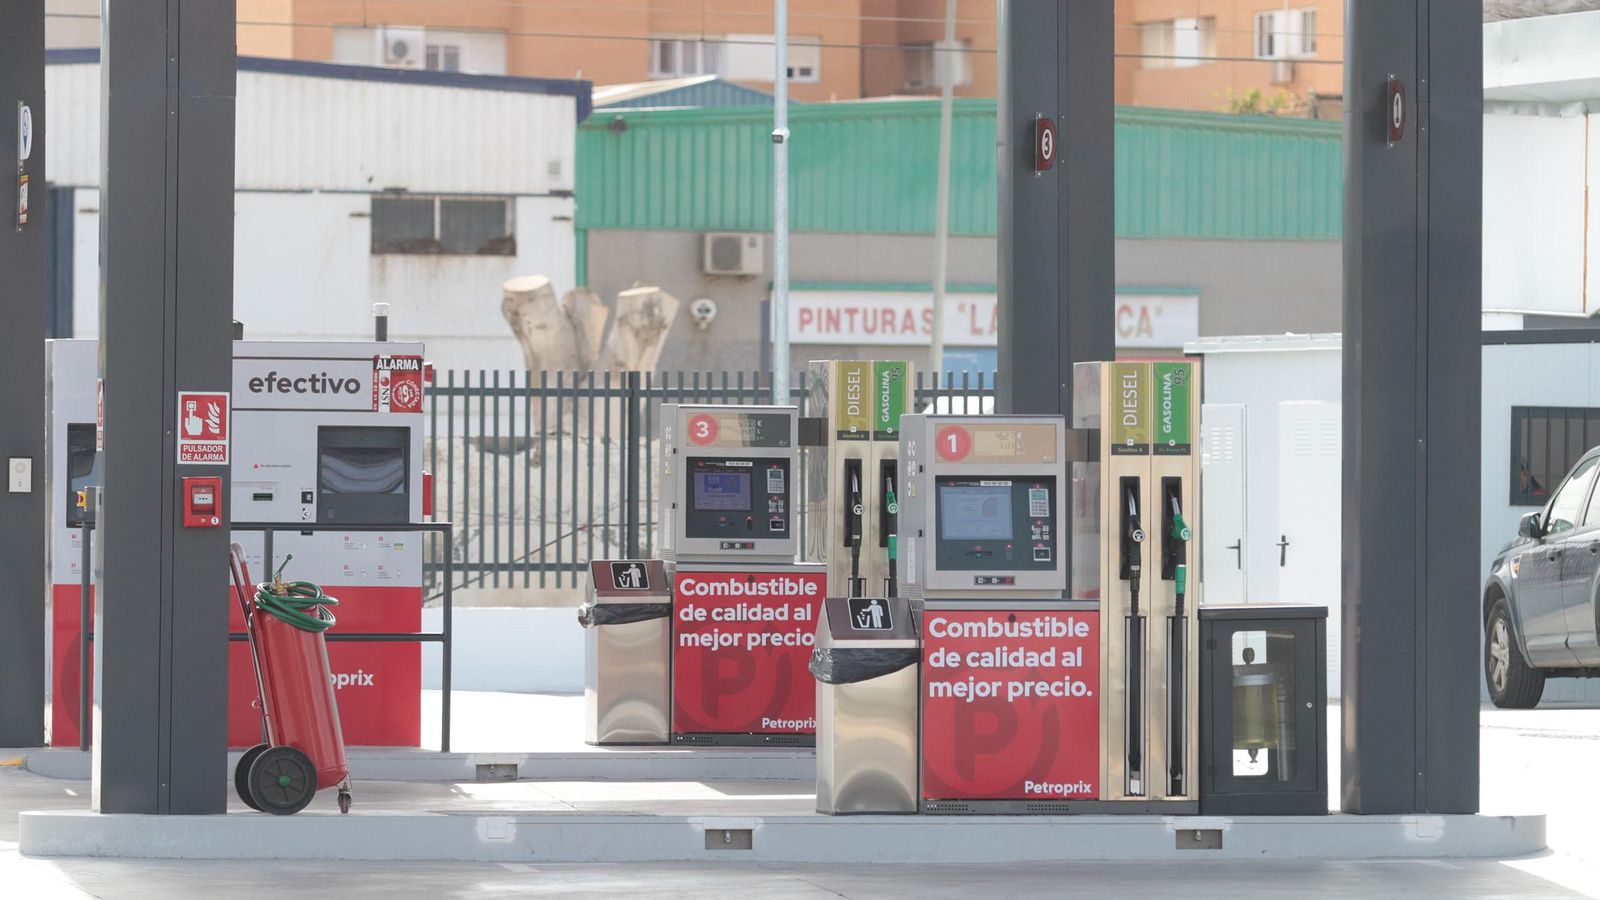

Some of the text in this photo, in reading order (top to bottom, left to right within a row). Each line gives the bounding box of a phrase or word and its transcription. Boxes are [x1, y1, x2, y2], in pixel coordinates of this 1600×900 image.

[798, 307, 936, 335] PINTURAS
[376, 359, 419, 370] ALARMA
[892, 367, 902, 381] 95
[248, 371, 361, 394] efectivo
[1174, 368, 1185, 385] 95
[848, 367, 860, 415] DIESEL
[882, 370, 890, 422] GASOLINA
[1123, 369, 1137, 426] DIESEL
[1163, 373, 1172, 433] GASOLINA
[696, 421, 708, 438] 3
[183, 445, 223, 453] PULSADOR
[947, 434, 957, 453] 1
[194, 453, 224, 461] ALARMA
[679, 577, 817, 596] Combustible
[679, 603, 812, 622] de calidad al
[928, 617, 1089, 638] Combustible
[679, 628, 742, 651] mejor
[928, 646, 1083, 668] de calidad al
[929, 676, 1093, 703] mejor precio.
[1024, 780, 1092, 796] Petroprix
